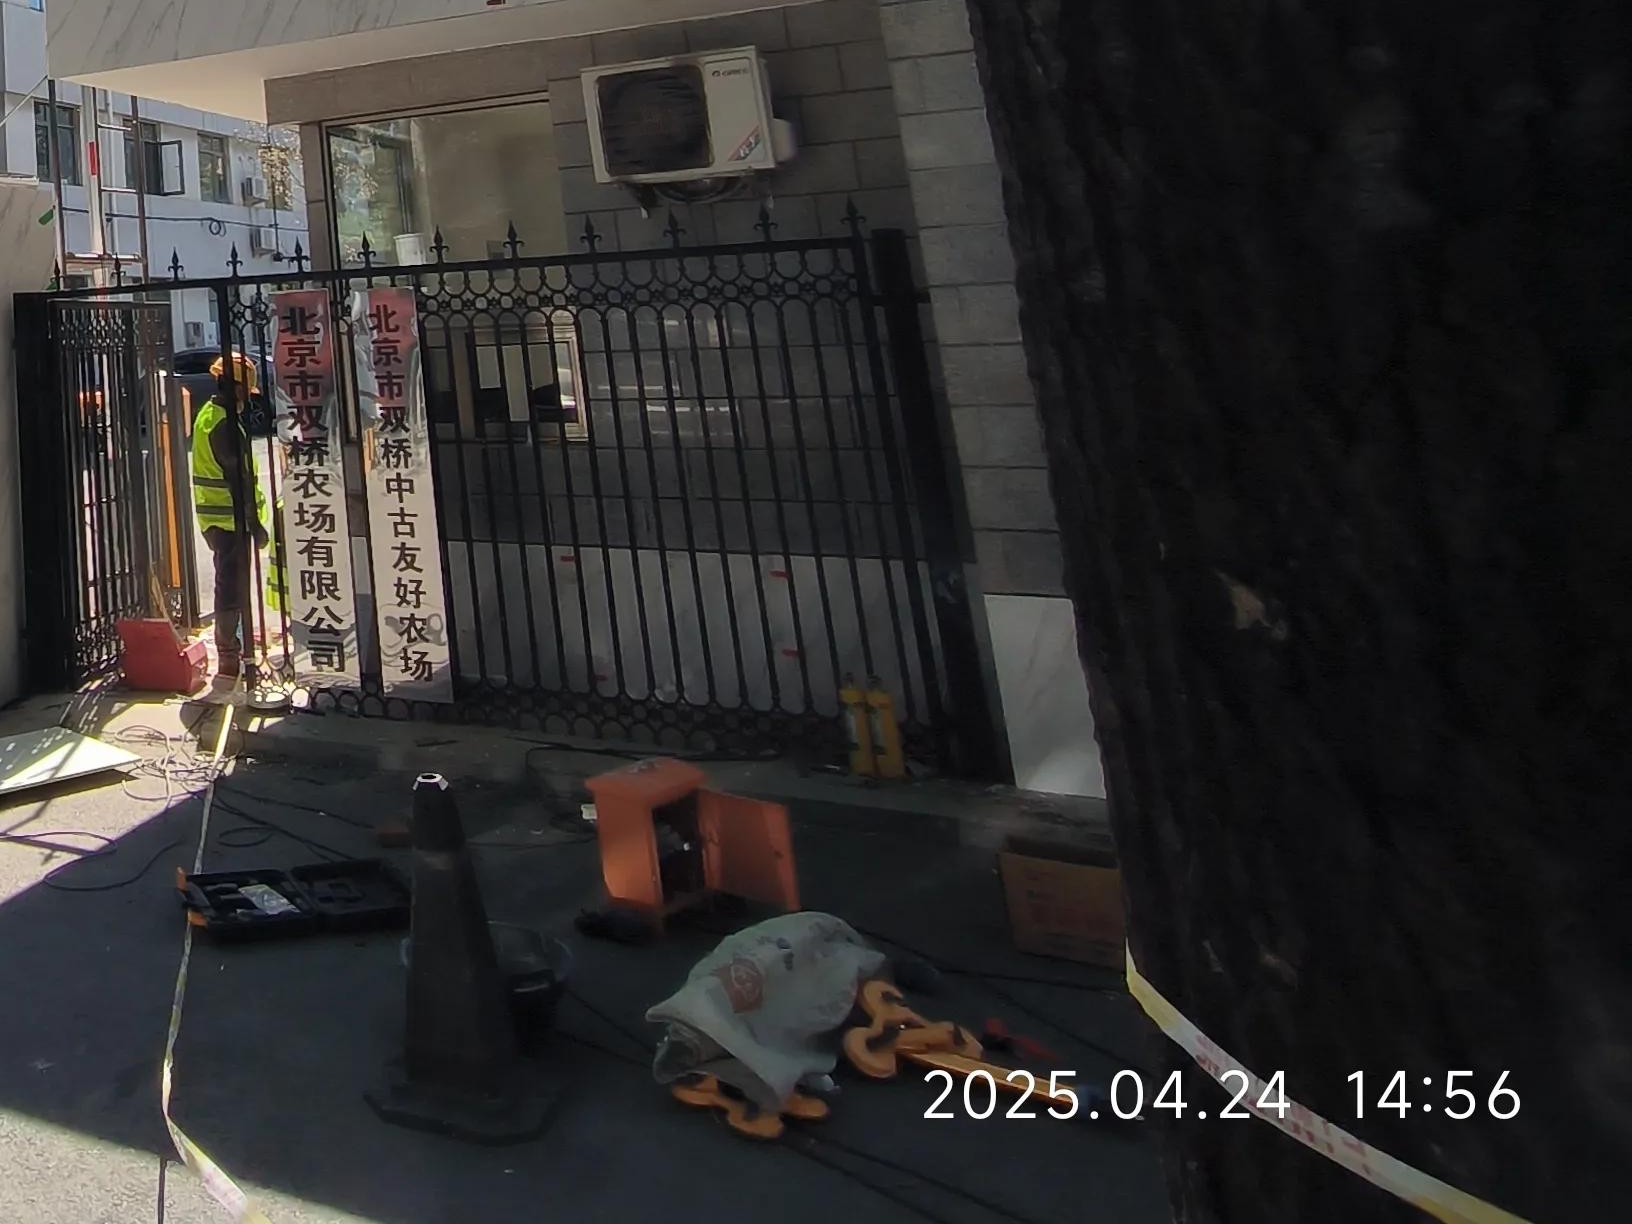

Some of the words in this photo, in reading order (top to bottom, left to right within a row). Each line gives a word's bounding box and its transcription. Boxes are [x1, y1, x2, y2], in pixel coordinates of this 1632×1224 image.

[279, 306, 345, 673] 北京市双桥农场有限公司
[368, 303, 434, 683] 北京市双桥中古友好农场
